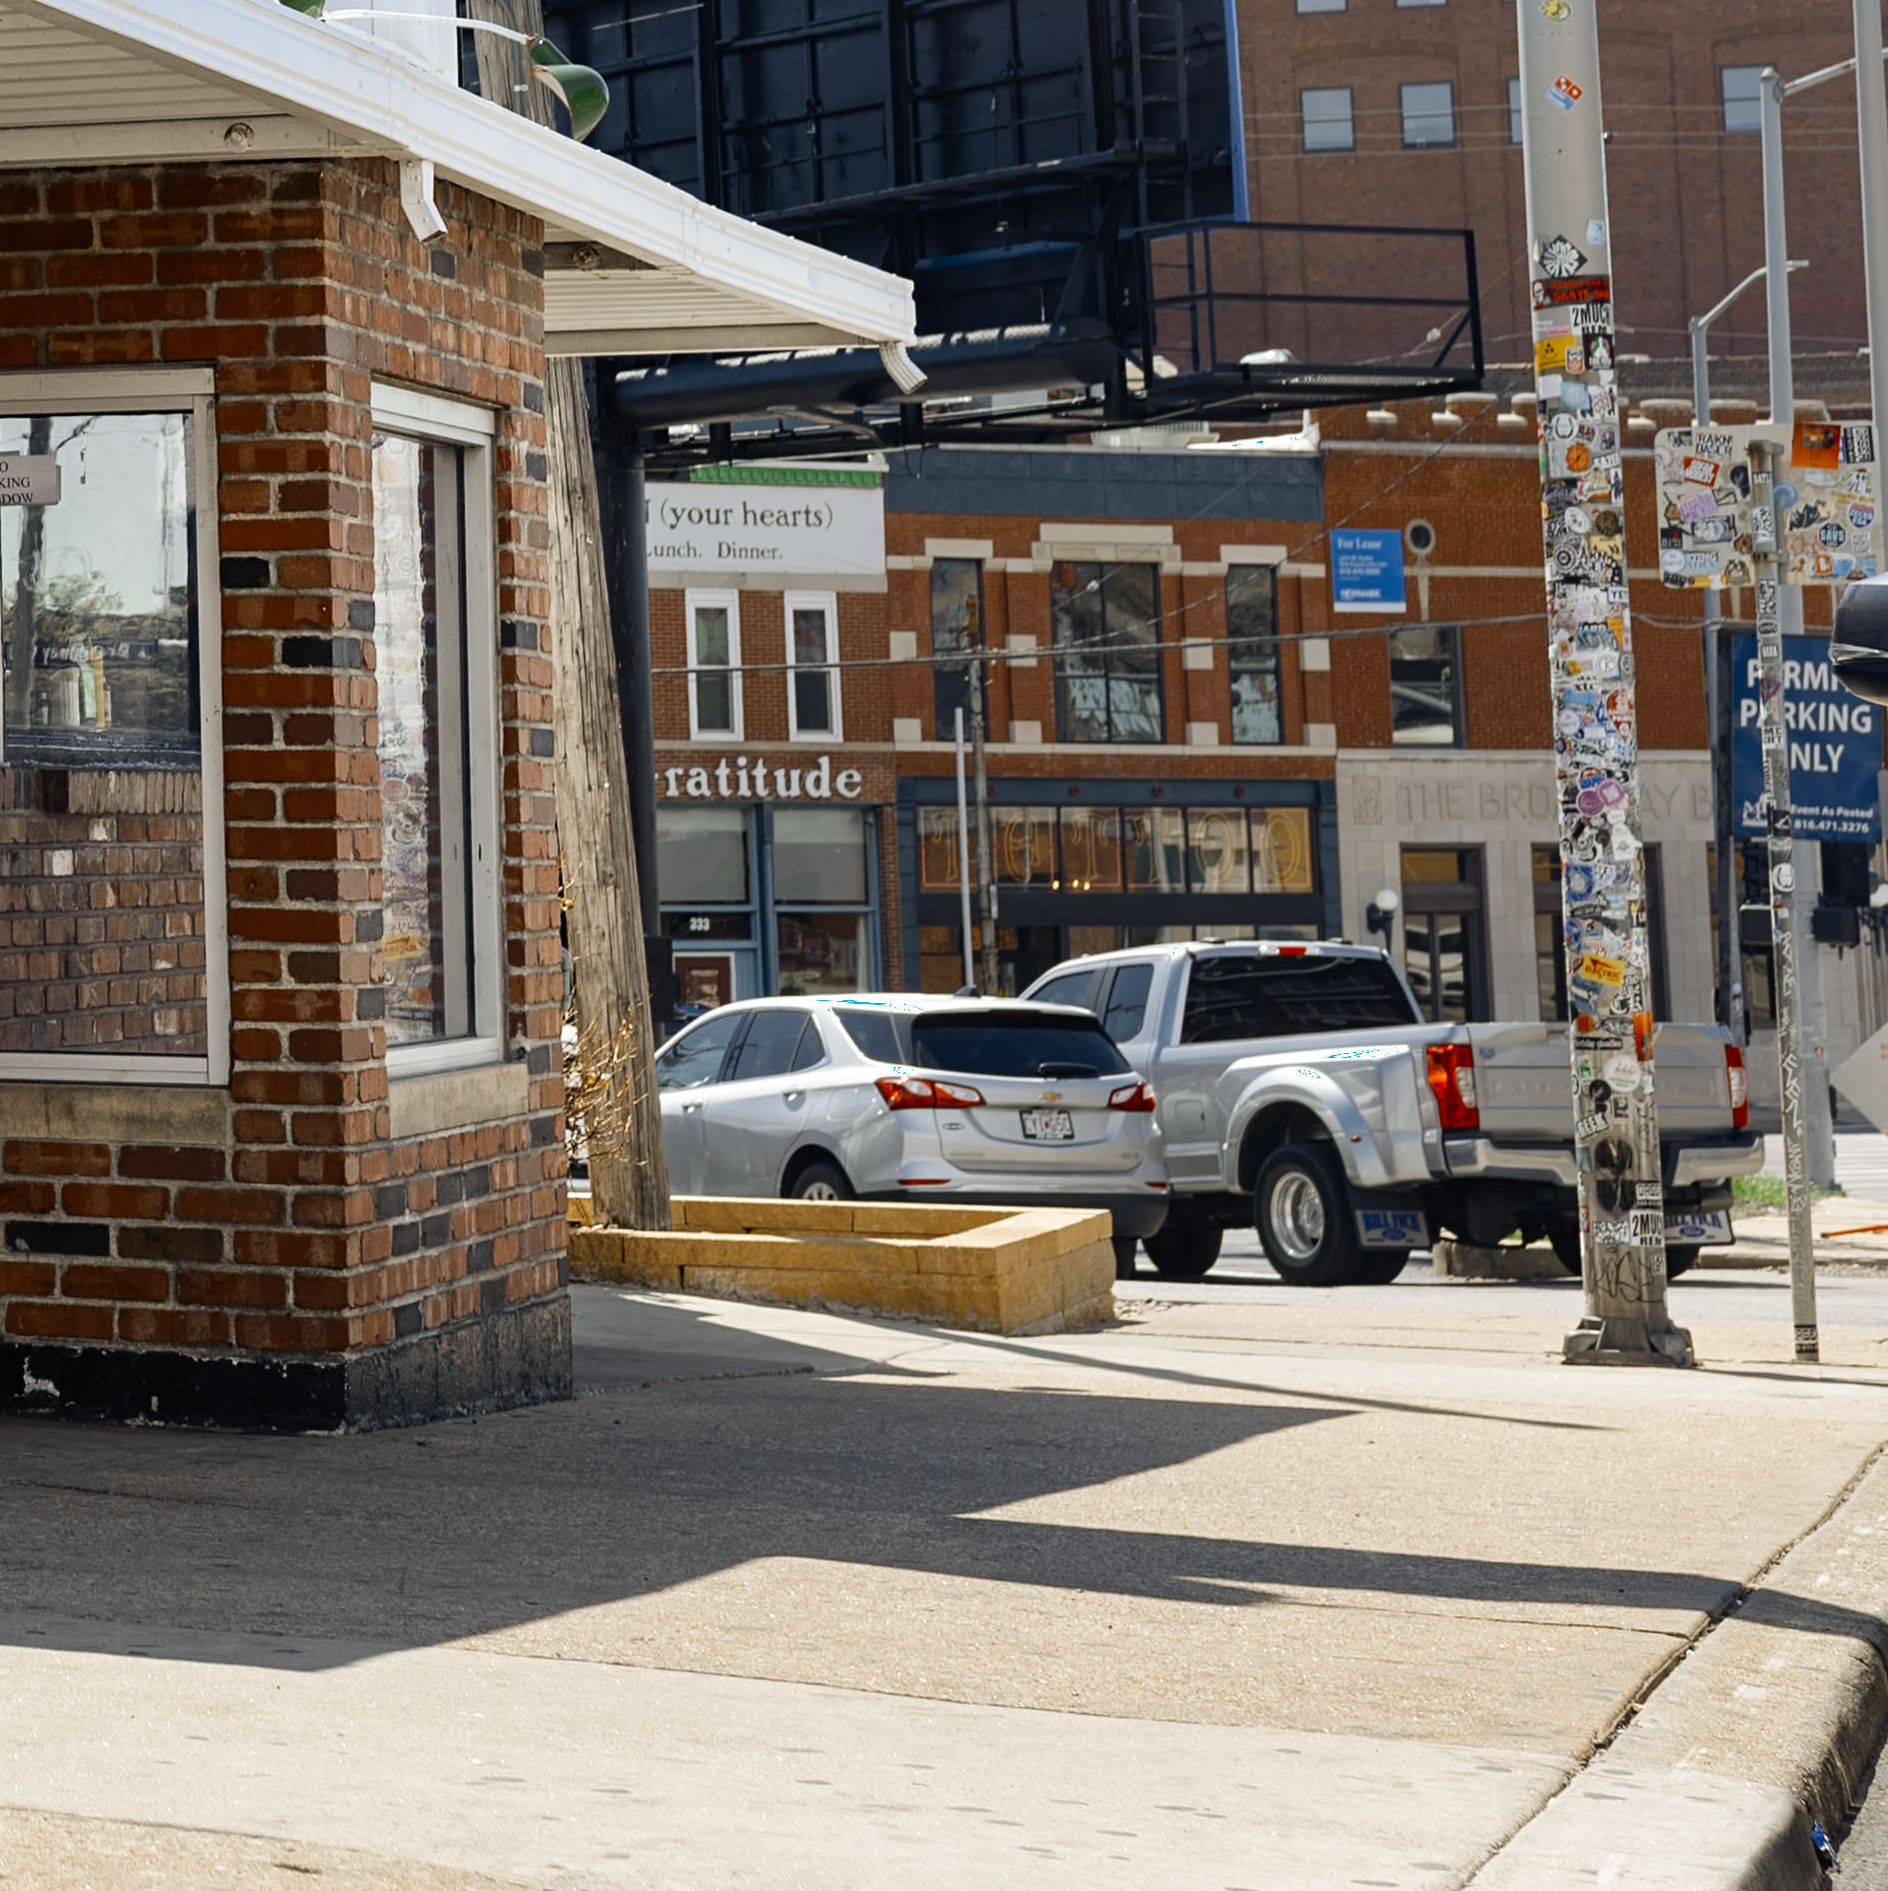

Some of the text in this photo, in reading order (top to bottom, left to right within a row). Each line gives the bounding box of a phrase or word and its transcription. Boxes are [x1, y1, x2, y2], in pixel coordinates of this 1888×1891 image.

[660, 497, 833, 530] (your hearts)
[717, 541, 783, 560] Dinner.
[1338, 537, 1382, 549] For Lease
[1747, 659, 1850, 692] PRMI
[1740, 698, 1872, 734] PRKING
[1790, 742, 1845, 774] NLY
[655, 755, 862, 799] ratitude
[1398, 783, 1465, 821] THE
[1822, 806, 1835, 816] As
[1837, 806, 1873, 818] Posted
[1794, 819, 1870, 834] 816.471.3276
[689, 917, 711, 932] 333
